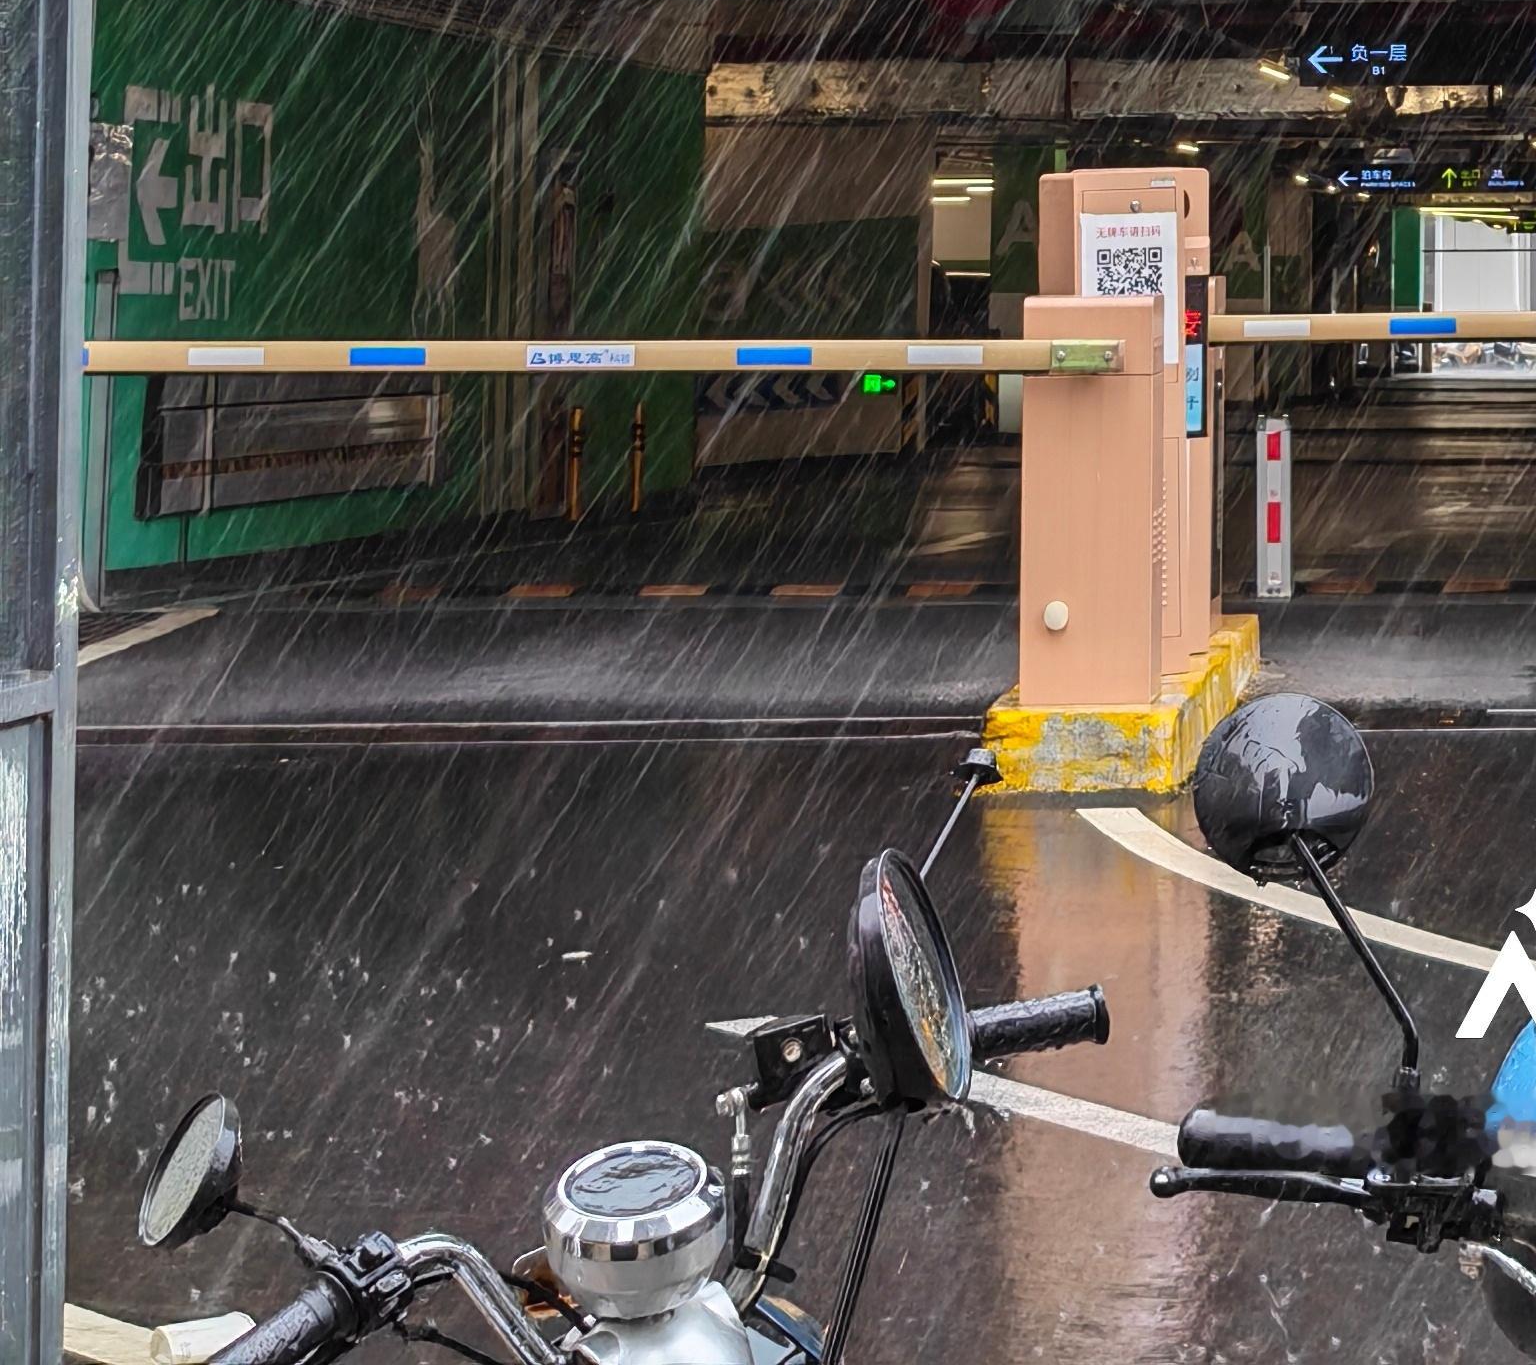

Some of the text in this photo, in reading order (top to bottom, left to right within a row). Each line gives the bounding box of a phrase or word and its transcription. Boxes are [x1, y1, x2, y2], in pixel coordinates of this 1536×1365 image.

[1350, 43, 1408, 62] 负一层
[1372, 65, 1386, 76] B1
[181, 84, 274, 235] 出口
[178, 259, 237, 322] EXIT
